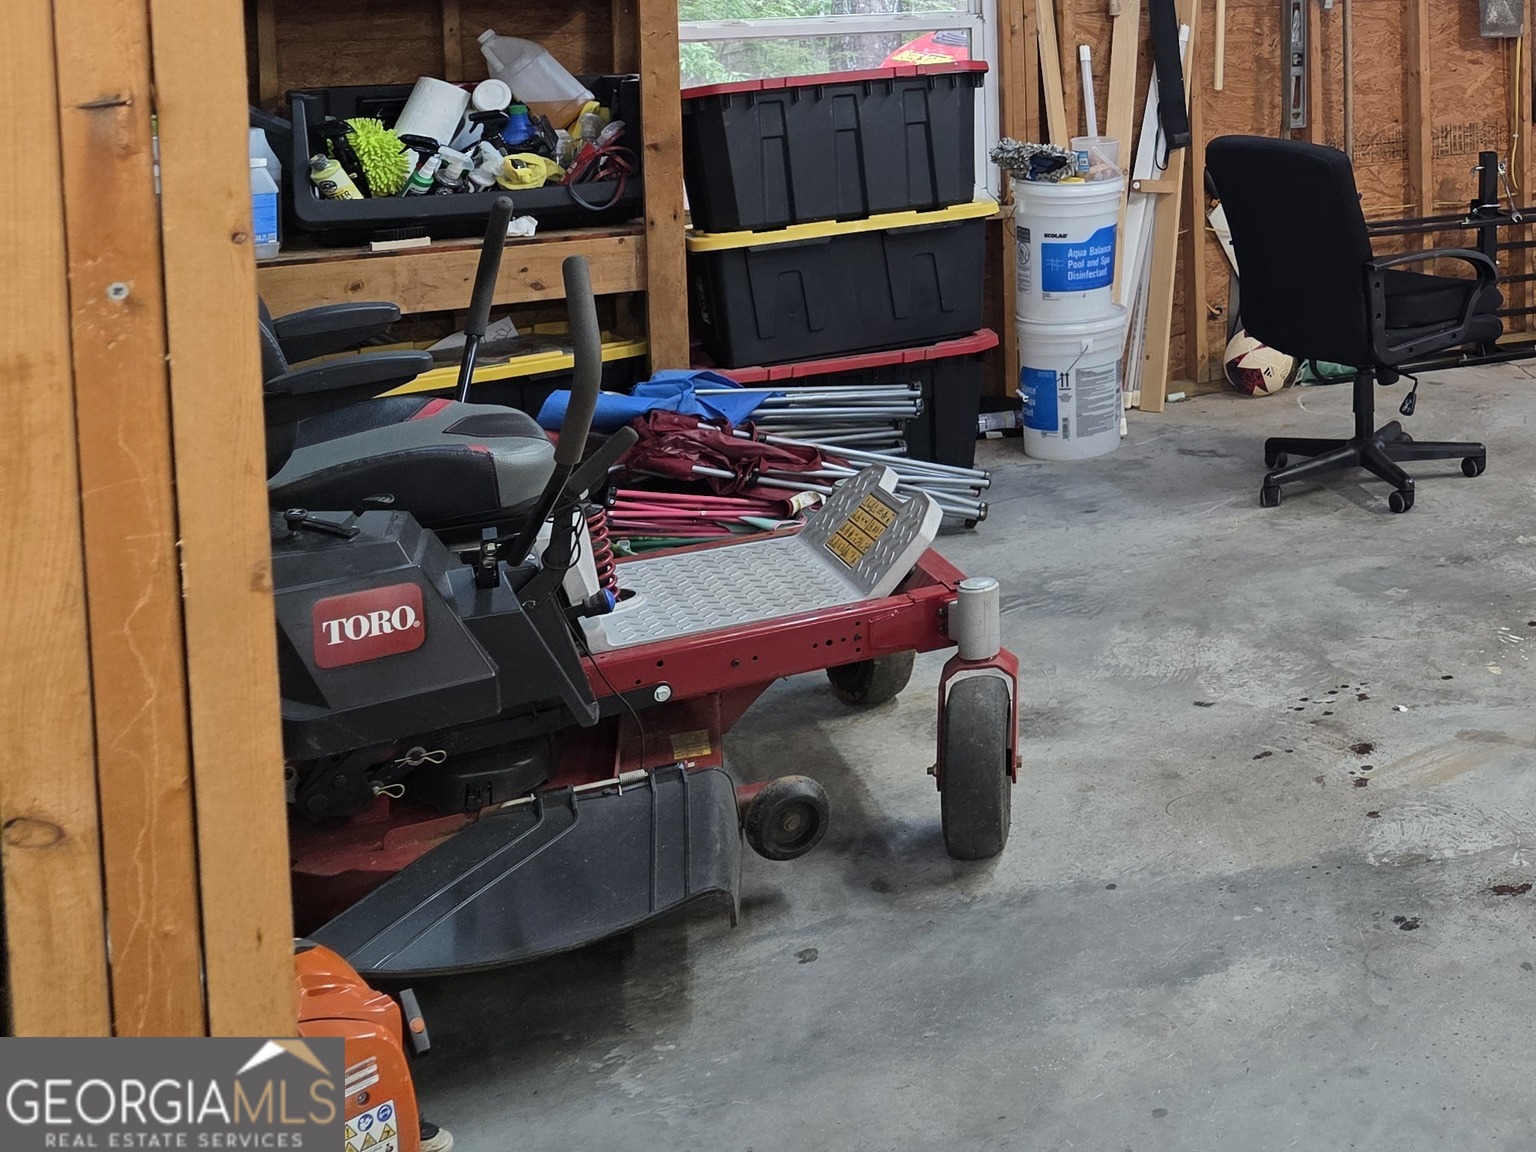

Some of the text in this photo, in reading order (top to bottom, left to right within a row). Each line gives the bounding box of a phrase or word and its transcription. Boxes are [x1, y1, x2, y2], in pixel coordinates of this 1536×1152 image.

[1067, 248, 1087, 259] Aqua
[1067, 256, 1111, 269] Pool and Spa
[1067, 267, 1108, 281] Disinfectant
[322, 605, 416, 646] TORO
